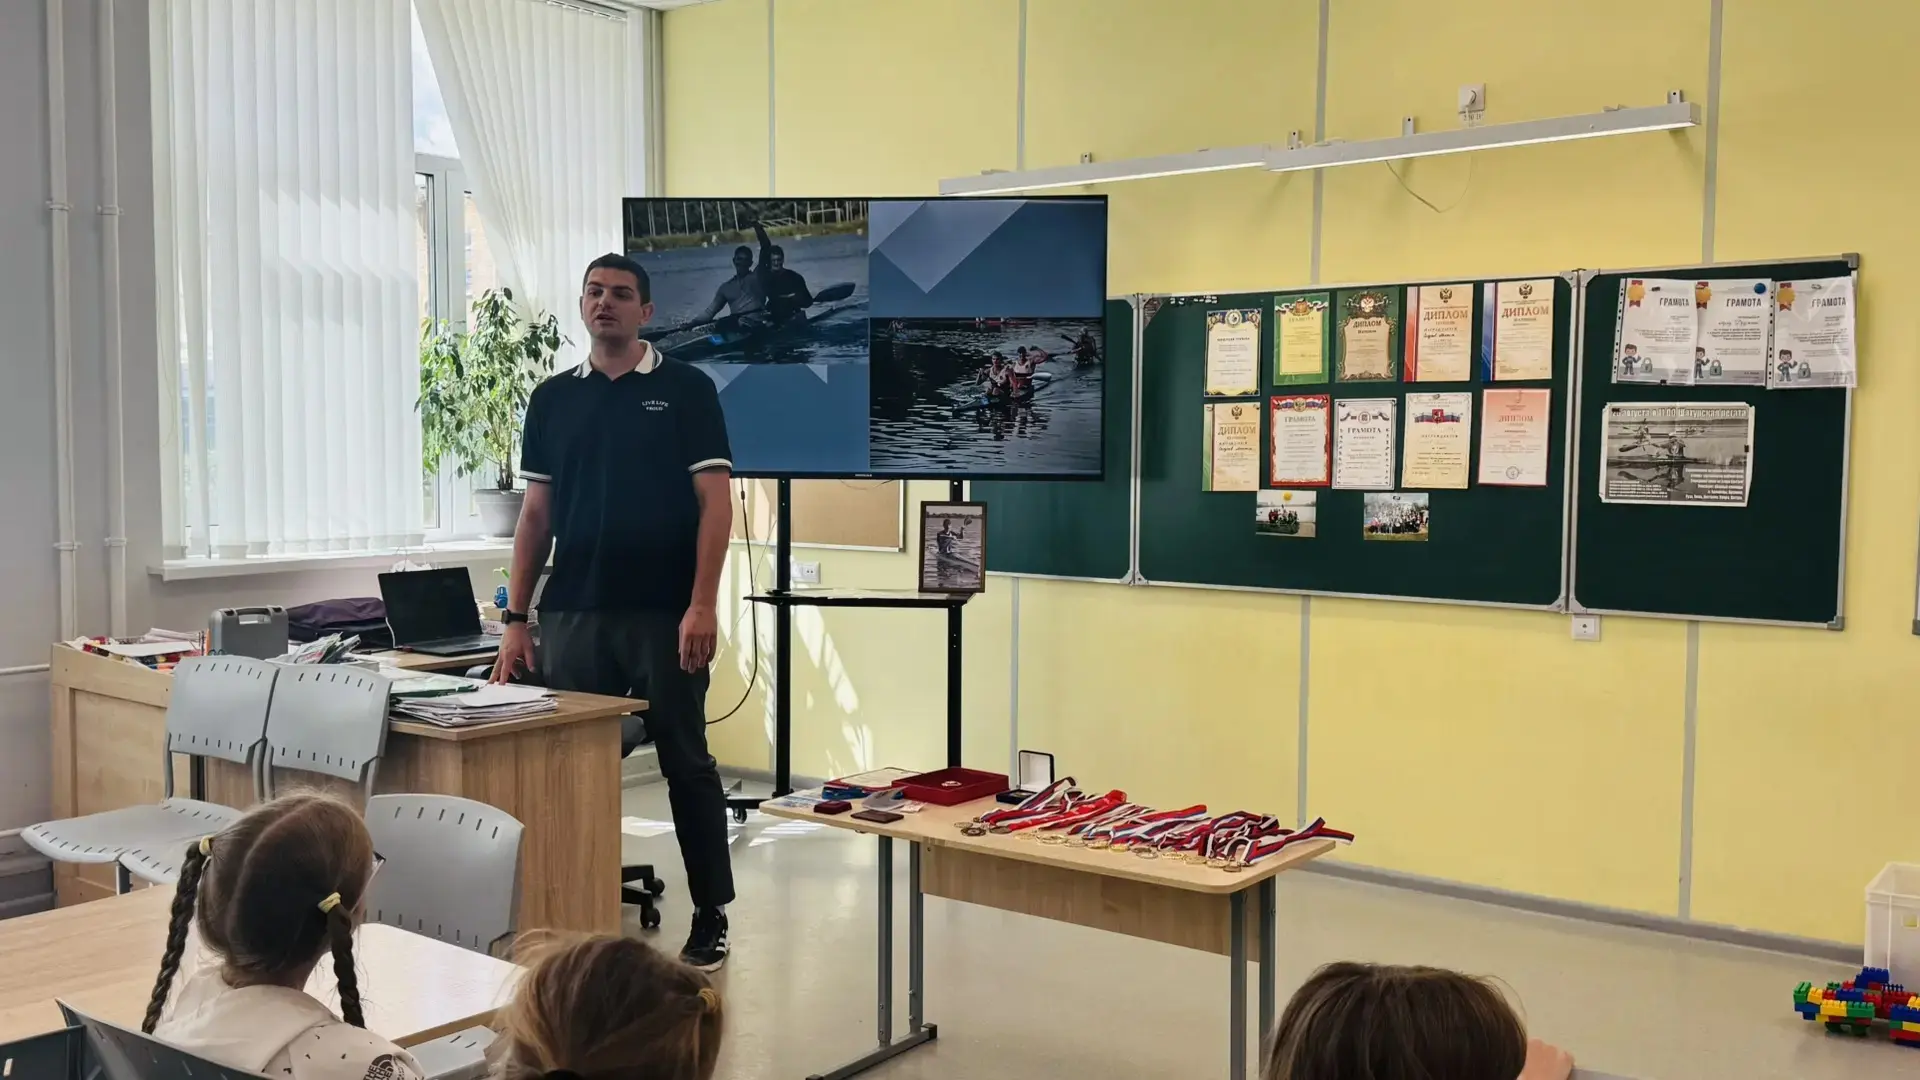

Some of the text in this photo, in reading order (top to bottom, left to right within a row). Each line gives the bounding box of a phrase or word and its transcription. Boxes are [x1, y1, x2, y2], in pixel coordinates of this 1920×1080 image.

[1659, 297, 1690, 307] ГРАМОТА
[1726, 297, 1762, 307] ГРАМОТА
[1811, 297, 1847, 308] ГРАМОТА
[1423, 310, 1468, 321] ДИПЛОМ
[1501, 306, 1549, 318] ДИПЛОМ
[1352, 320, 1382, 328] ДИПЛОМ
[1217, 426, 1257, 436] ДИПЛОМ
